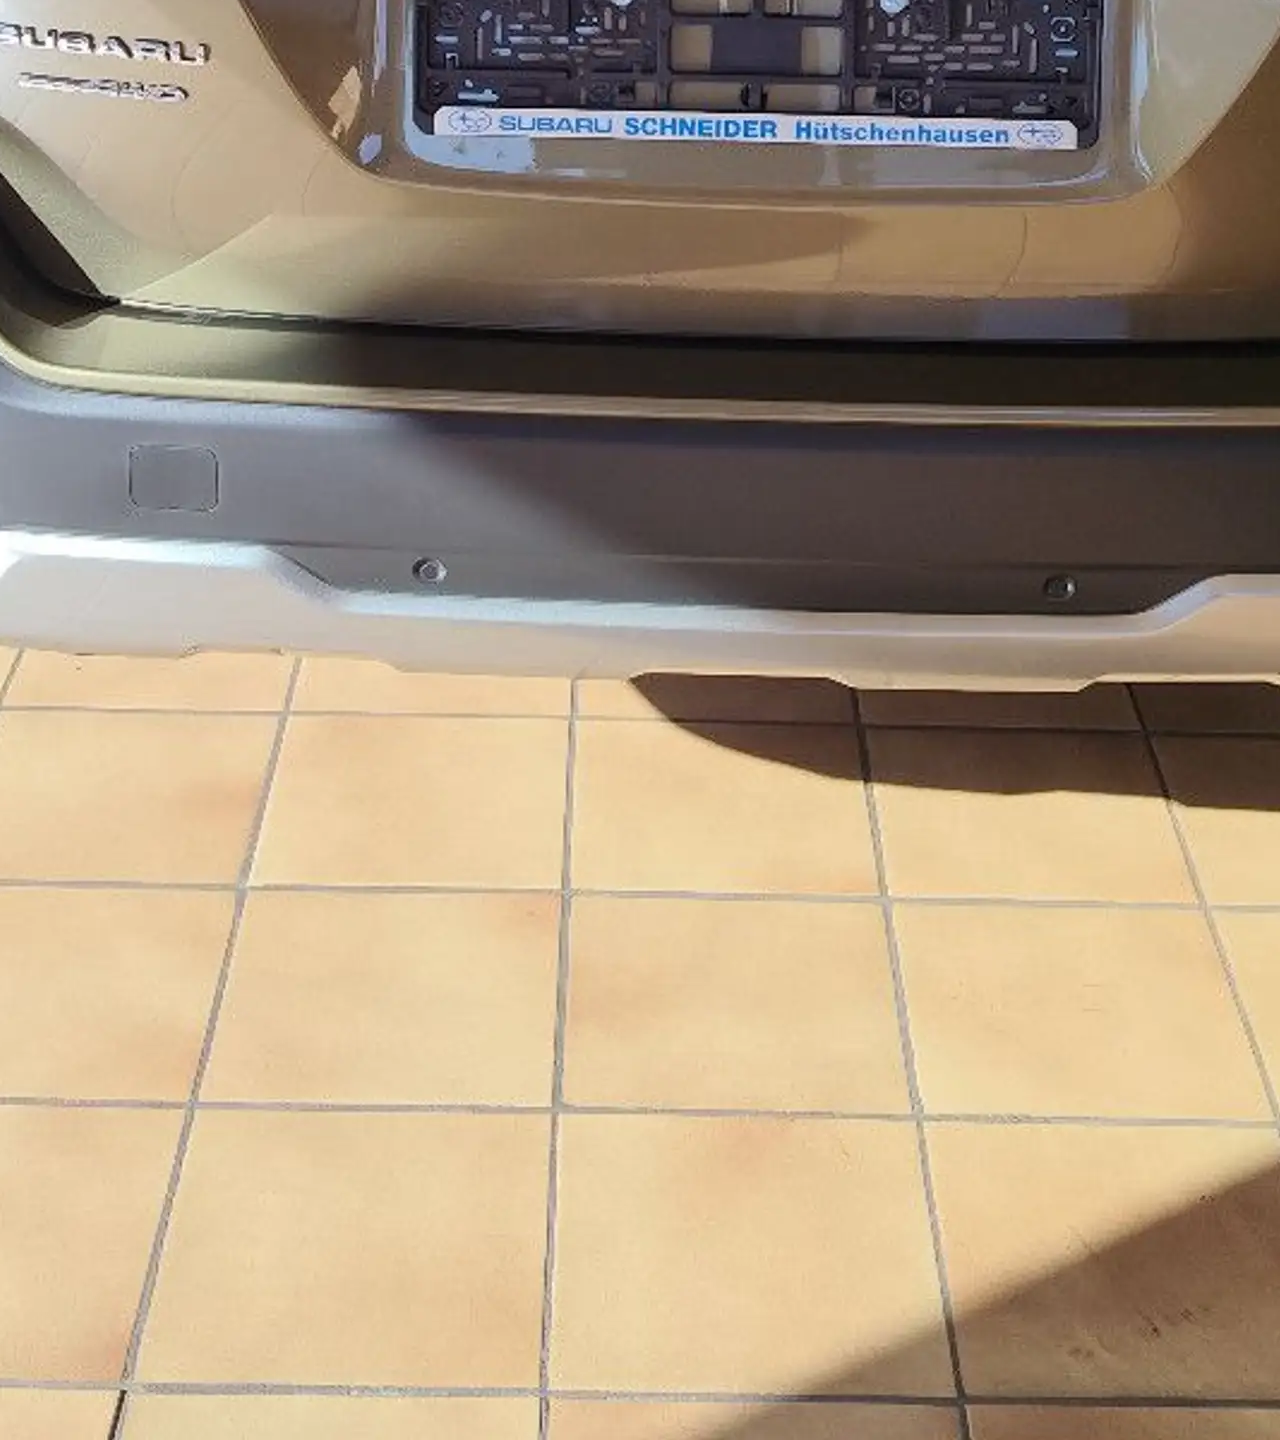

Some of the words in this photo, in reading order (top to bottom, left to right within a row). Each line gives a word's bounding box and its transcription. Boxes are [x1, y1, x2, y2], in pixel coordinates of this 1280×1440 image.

[499, 115, 613, 134] SUBARU
[624, 117, 778, 139] SCHNEIDER
[795, 120, 1009, 144] Hütschenhausen
